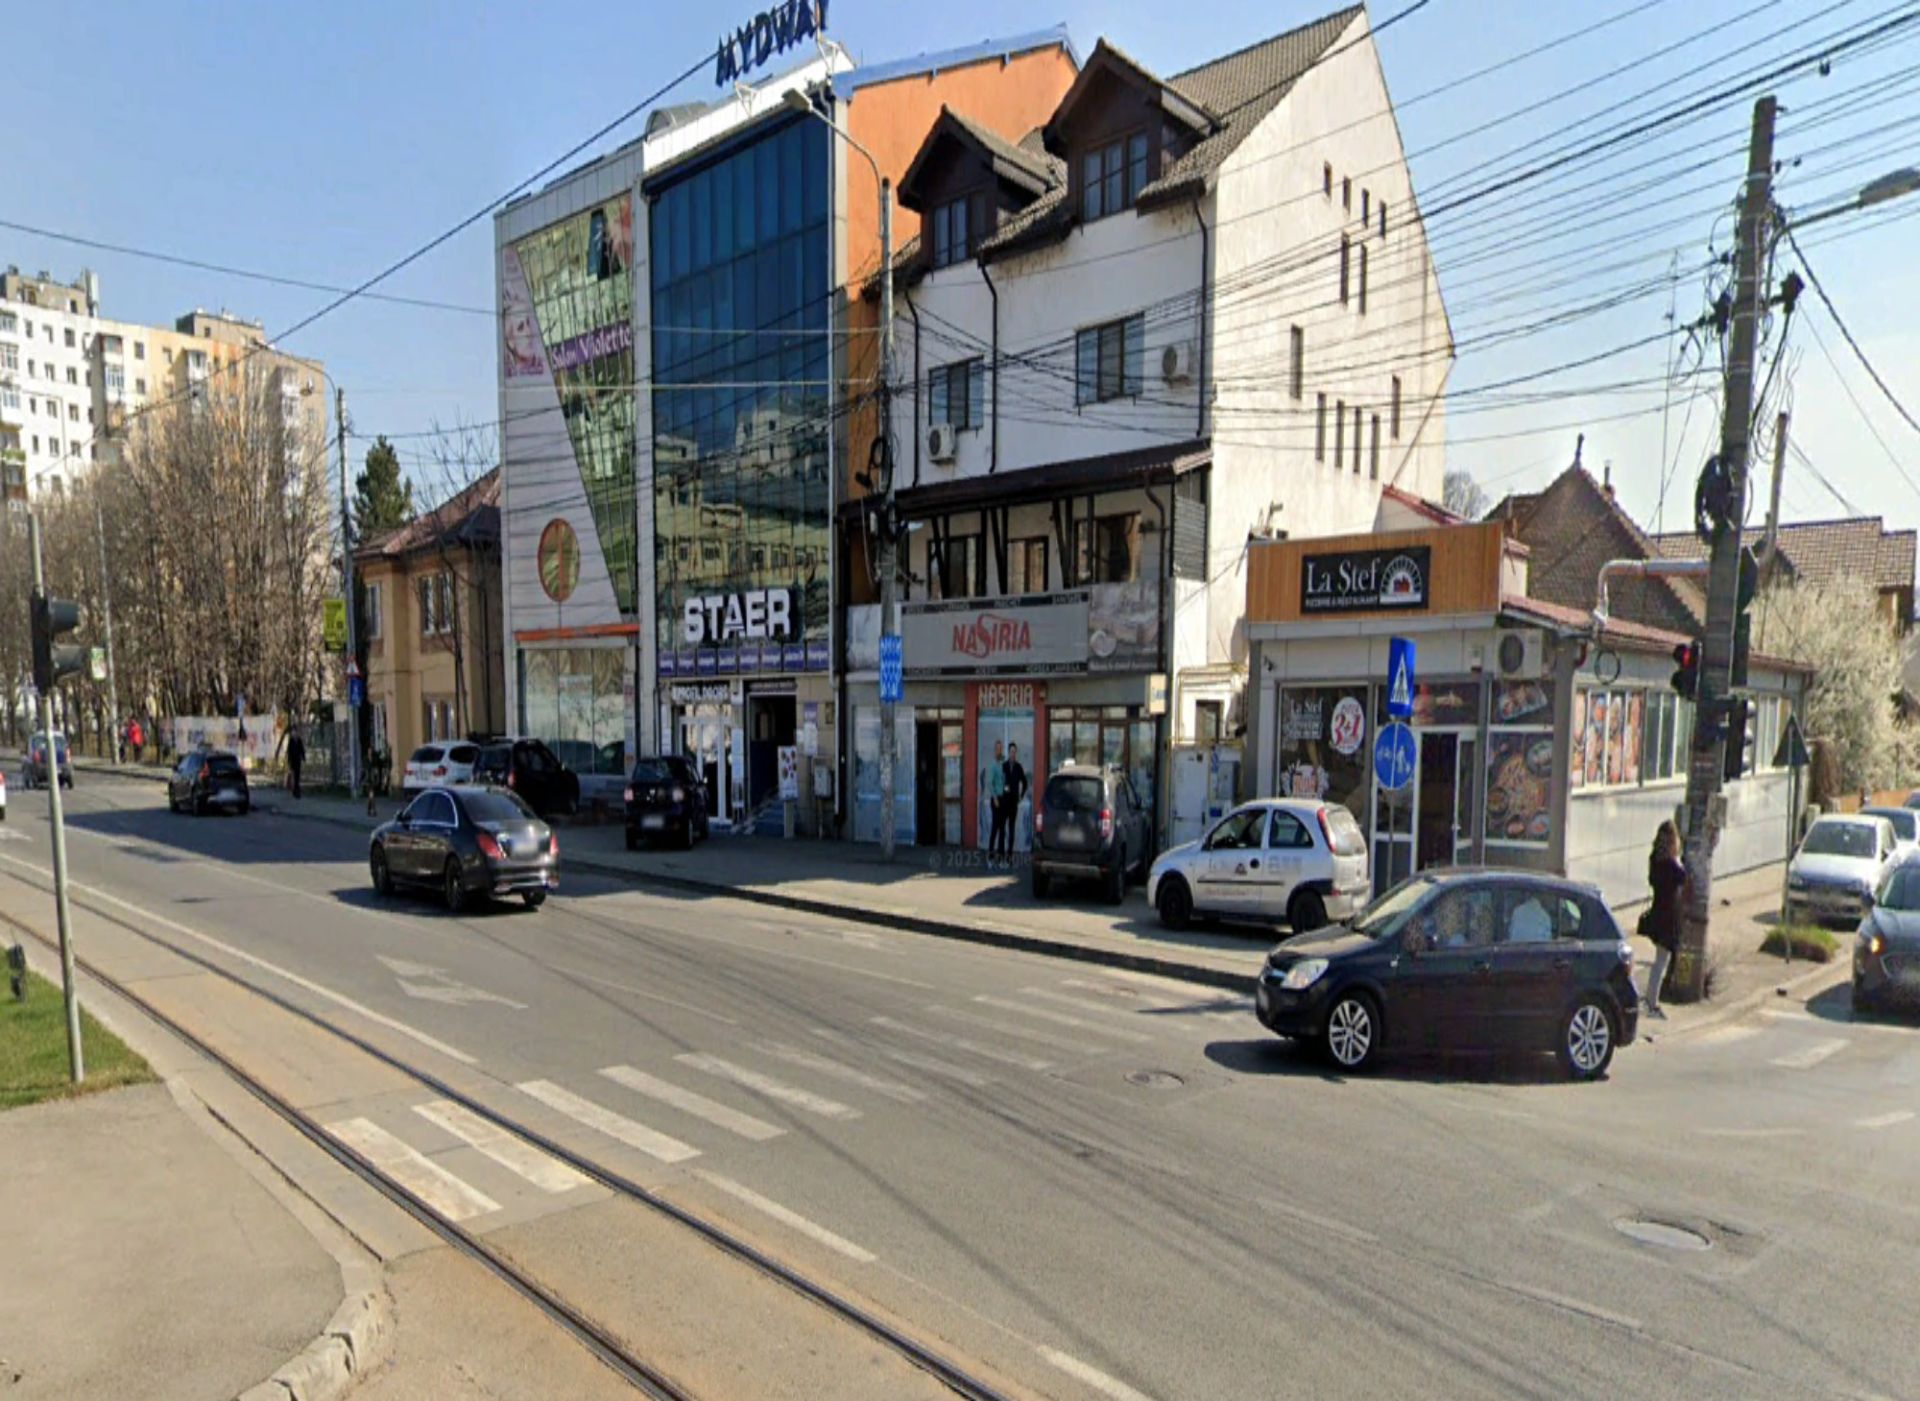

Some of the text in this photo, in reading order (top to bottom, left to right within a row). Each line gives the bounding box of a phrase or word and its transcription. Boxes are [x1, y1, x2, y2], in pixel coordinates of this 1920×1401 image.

[1306, 561, 1332, 593] La
[684, 589, 791, 642] STAER
[953, 614, 1031, 659] NASIRIA
[978, 684, 1033, 708] NASIRIA
